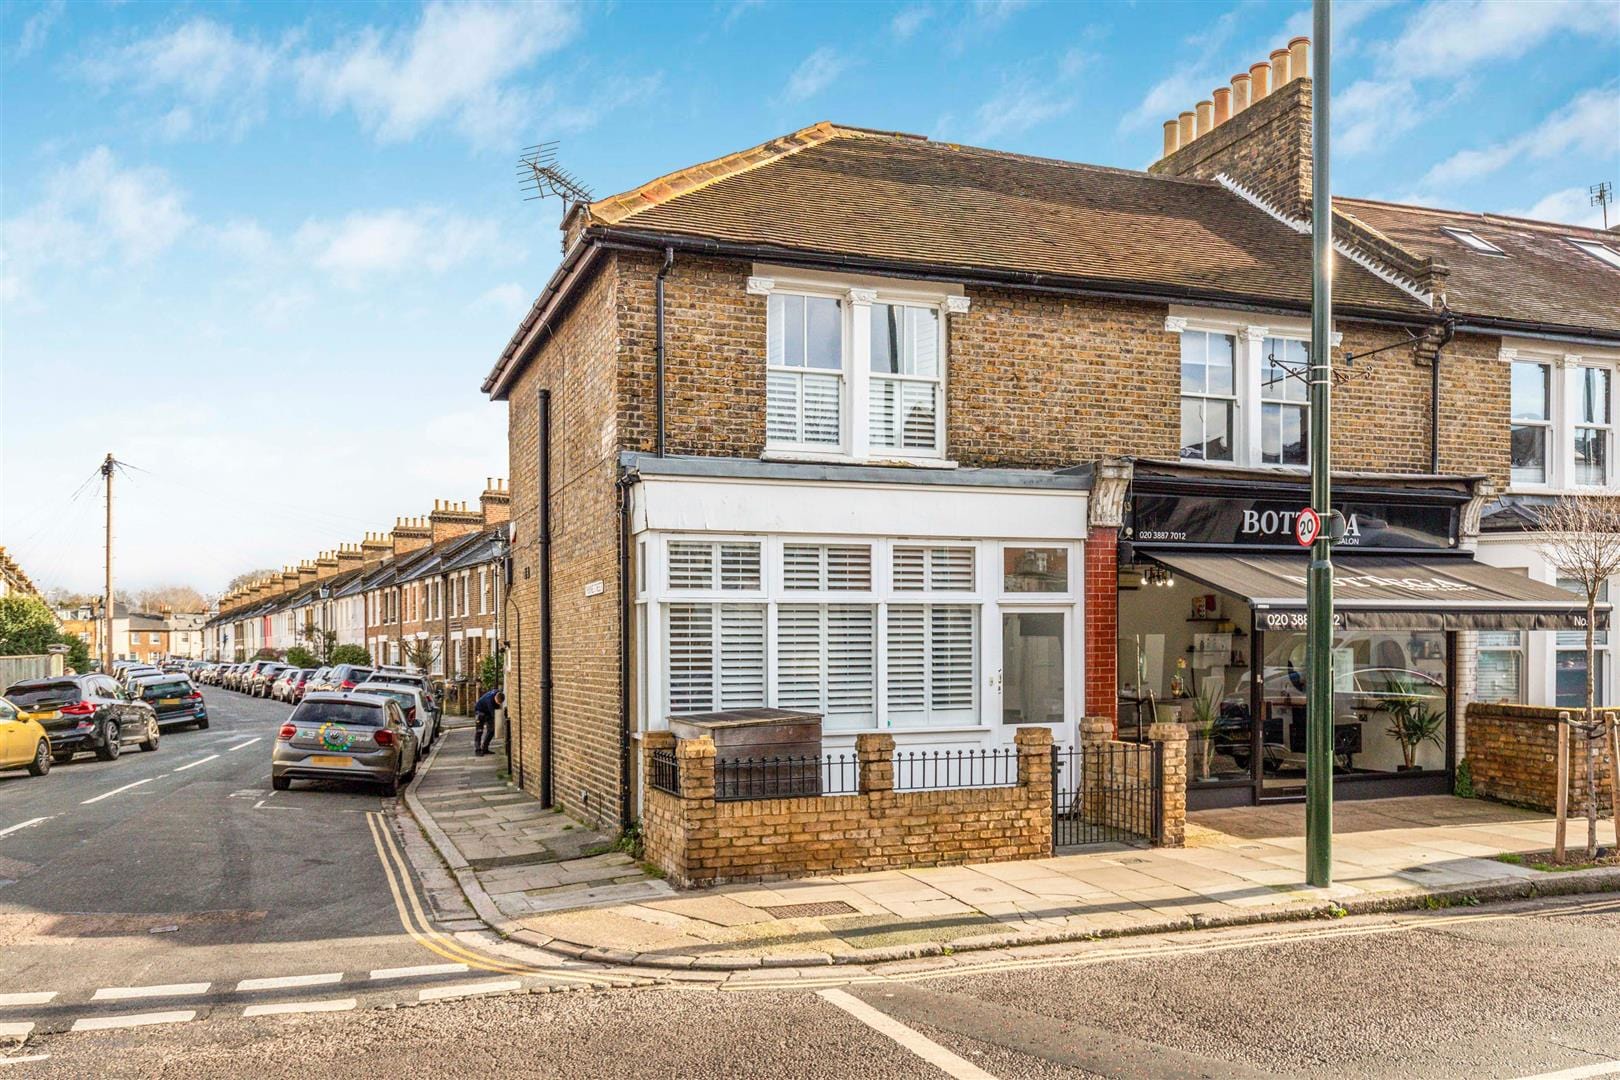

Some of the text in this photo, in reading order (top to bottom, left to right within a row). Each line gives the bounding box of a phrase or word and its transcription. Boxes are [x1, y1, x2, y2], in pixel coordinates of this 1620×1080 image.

[1242, 510, 1360, 537] BOTA
[1300, 519, 1314, 536] 20
[1139, 531, 1186, 540] 020 3887 7012
[1267, 614, 1289, 626] 020
